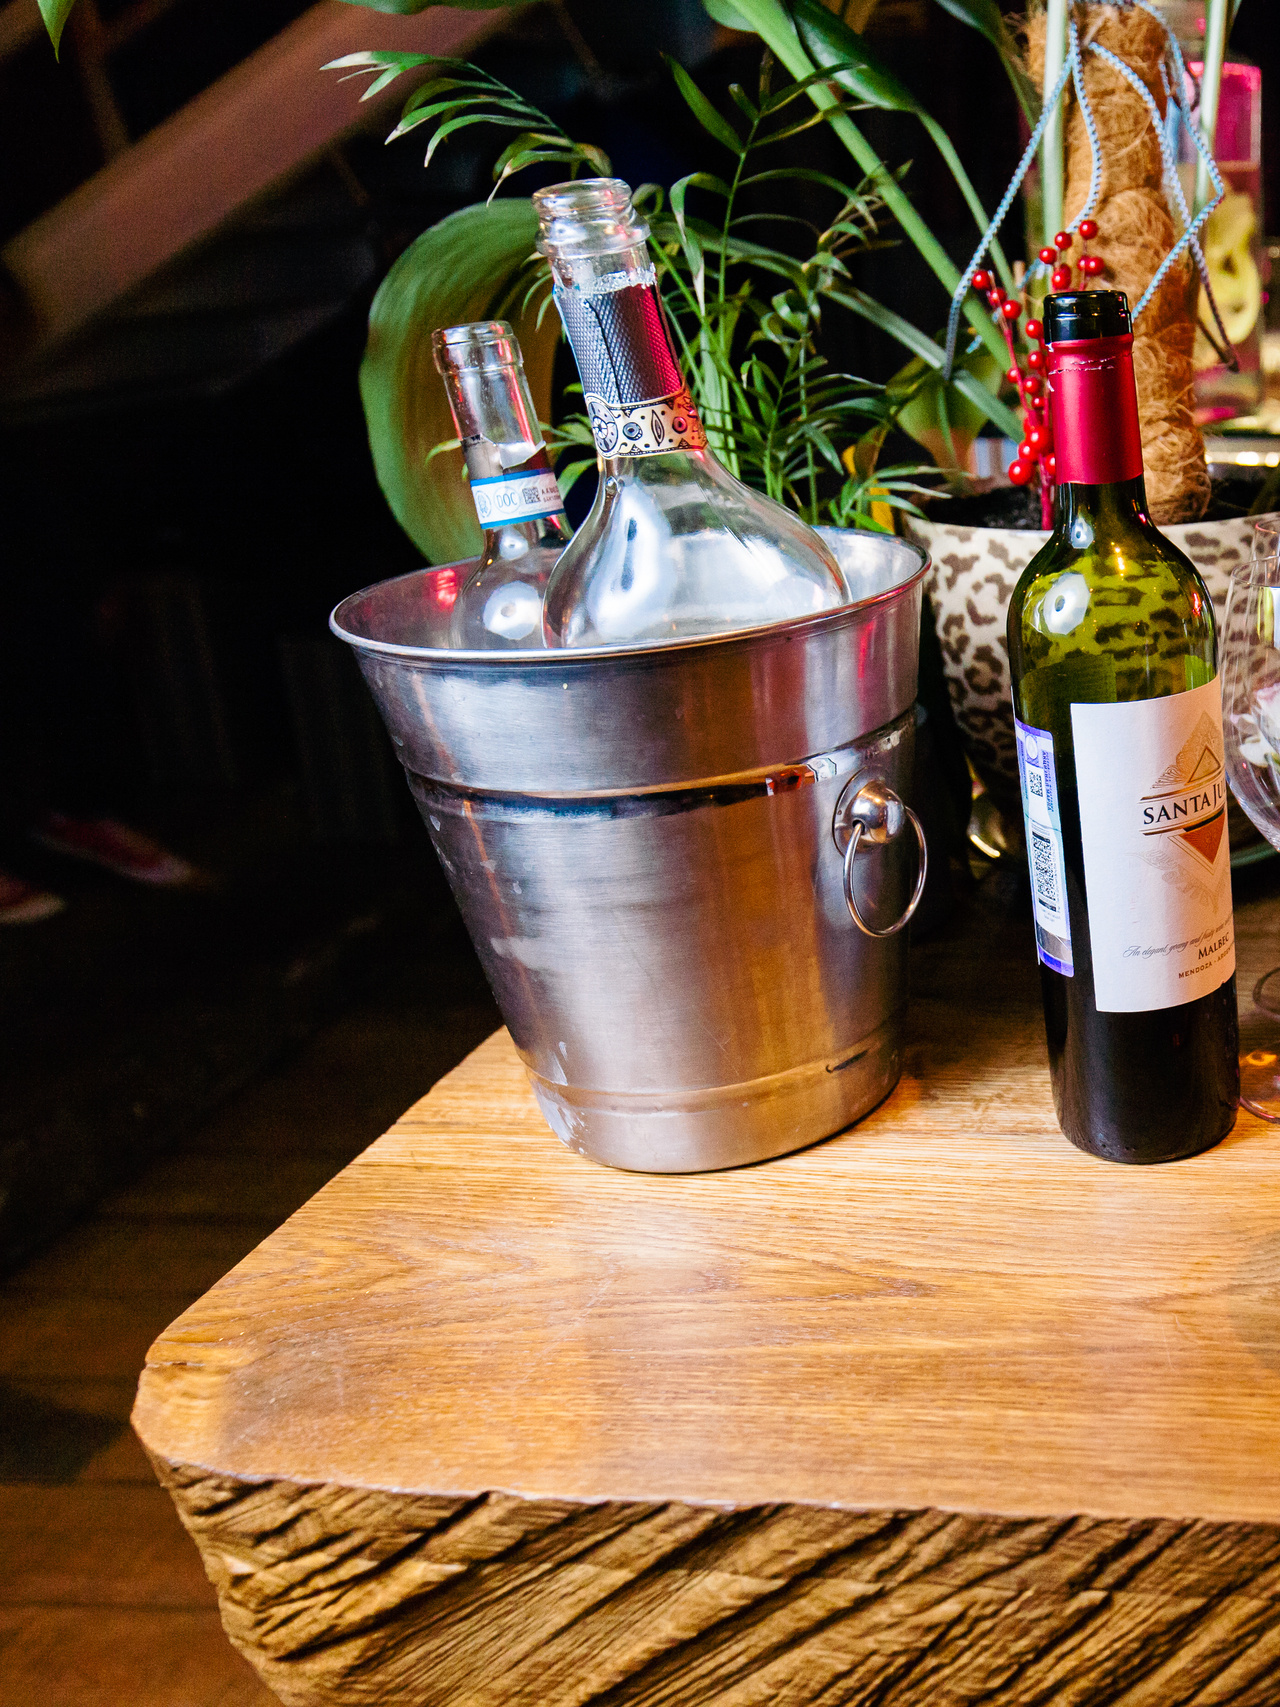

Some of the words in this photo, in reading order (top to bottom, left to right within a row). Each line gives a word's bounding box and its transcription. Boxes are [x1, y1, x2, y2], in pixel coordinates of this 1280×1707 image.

[496, 492, 518, 509] DOC
[1143, 791, 1211, 825] SANTA
[1123, 946, 1141, 957] An
[1198, 931, 1229, 960] MALBEC
[1178, 961, 1213, 979] MENDOZA
